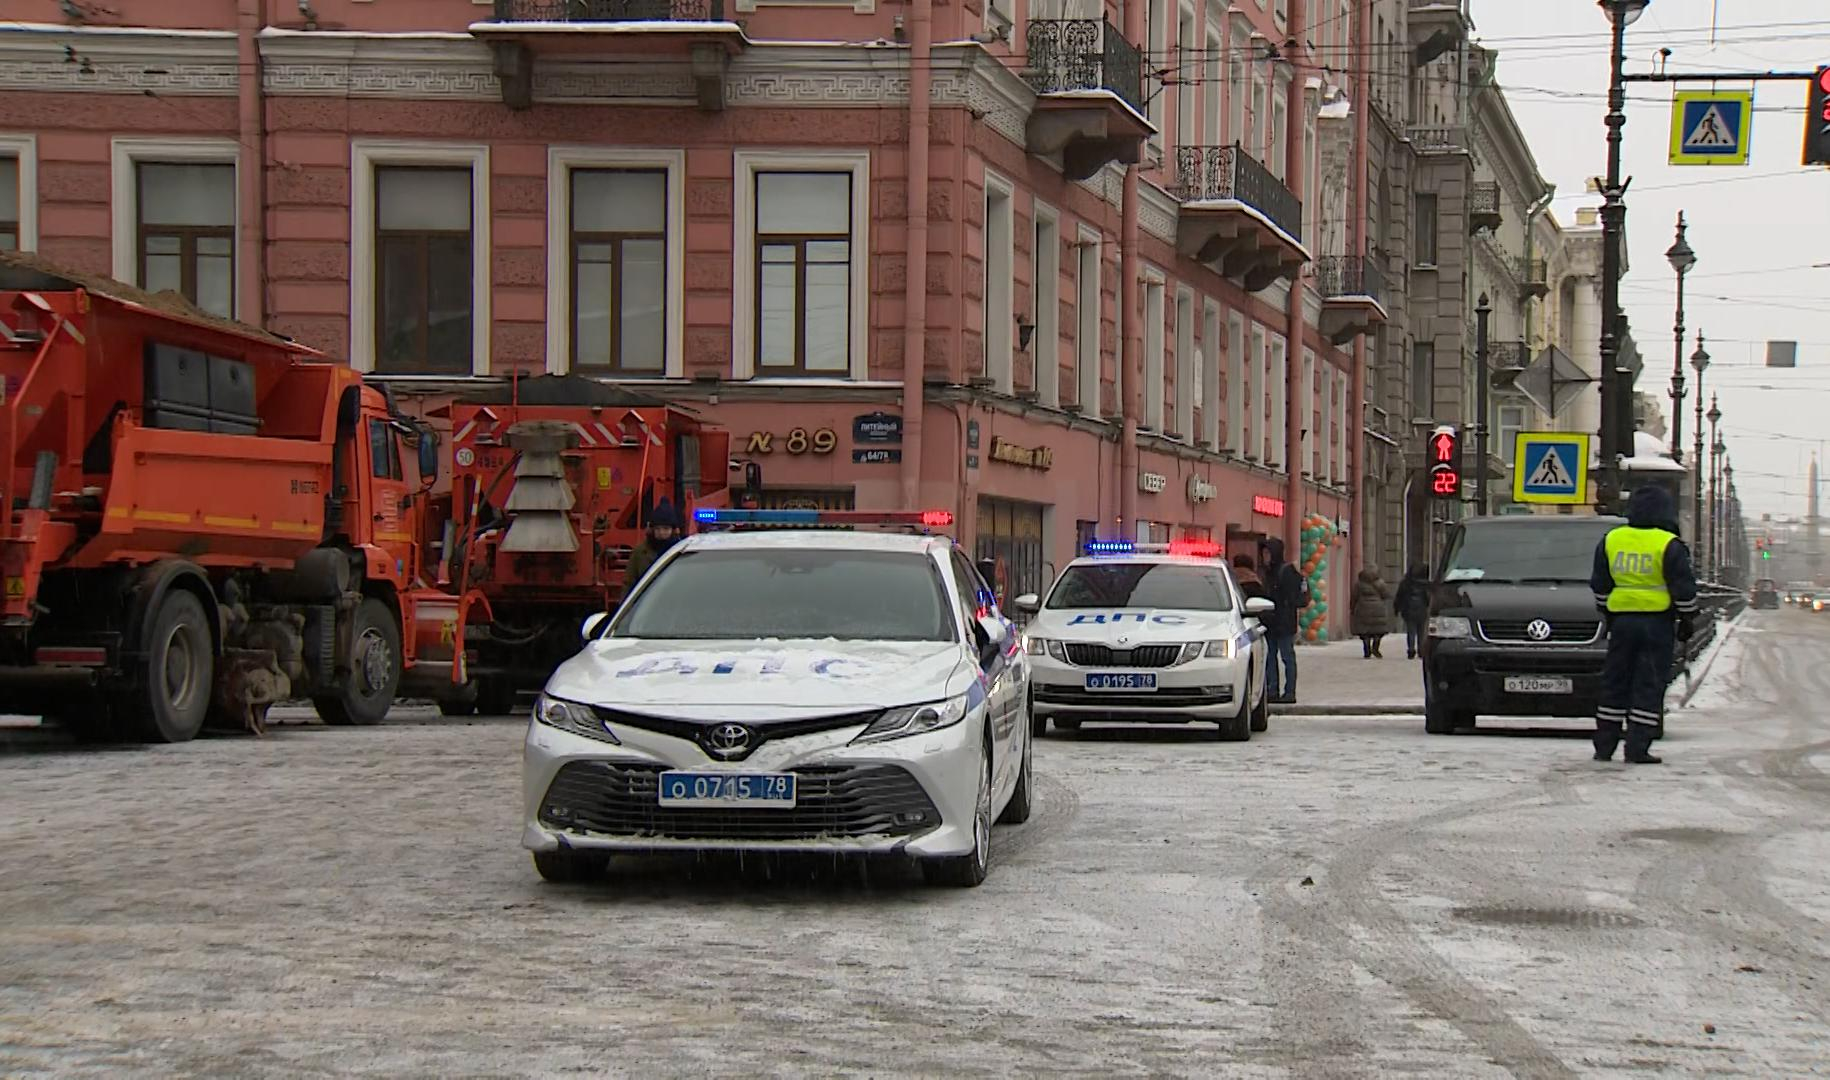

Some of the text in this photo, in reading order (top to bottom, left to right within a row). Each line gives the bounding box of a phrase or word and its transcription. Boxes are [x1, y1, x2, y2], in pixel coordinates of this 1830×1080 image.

[787, 429, 836, 454] 89
[459, 451, 472, 464] 50
[1434, 473, 1455, 493] 22
[1613, 551, 1653, 575] ДПС
[1066, 613, 1187, 626] ДПС
[1103, 675, 1133, 687] 0195
[1141, 675, 1153, 684] 78
[694, 777, 751, 799] 0715
[765, 777, 787, 793] 78
